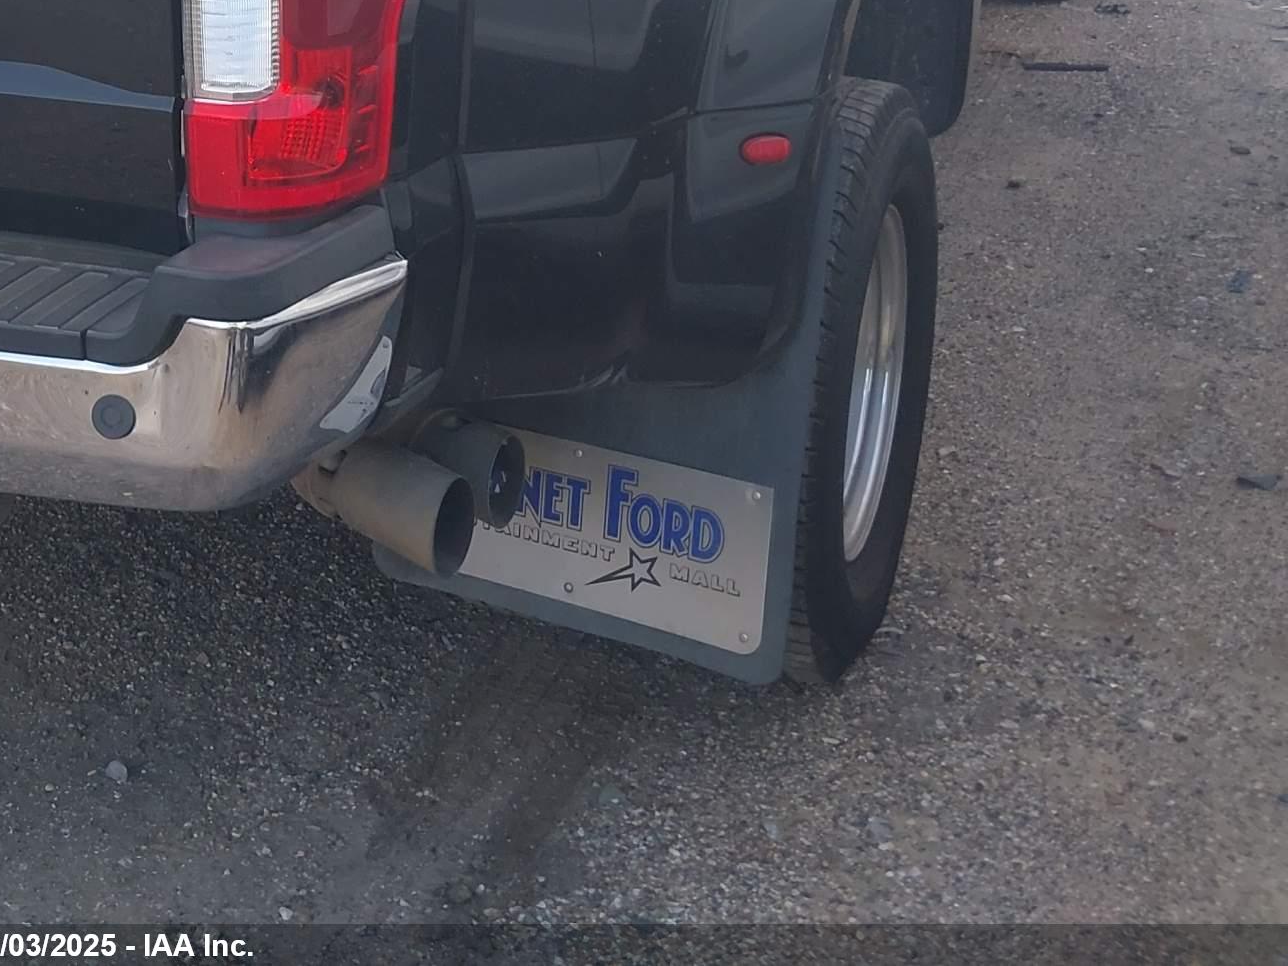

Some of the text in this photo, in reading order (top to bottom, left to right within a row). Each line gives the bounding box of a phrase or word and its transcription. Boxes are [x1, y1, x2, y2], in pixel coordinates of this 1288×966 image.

[512, 463, 726, 564] NET FORD
[668, 562, 741, 598] MALL
